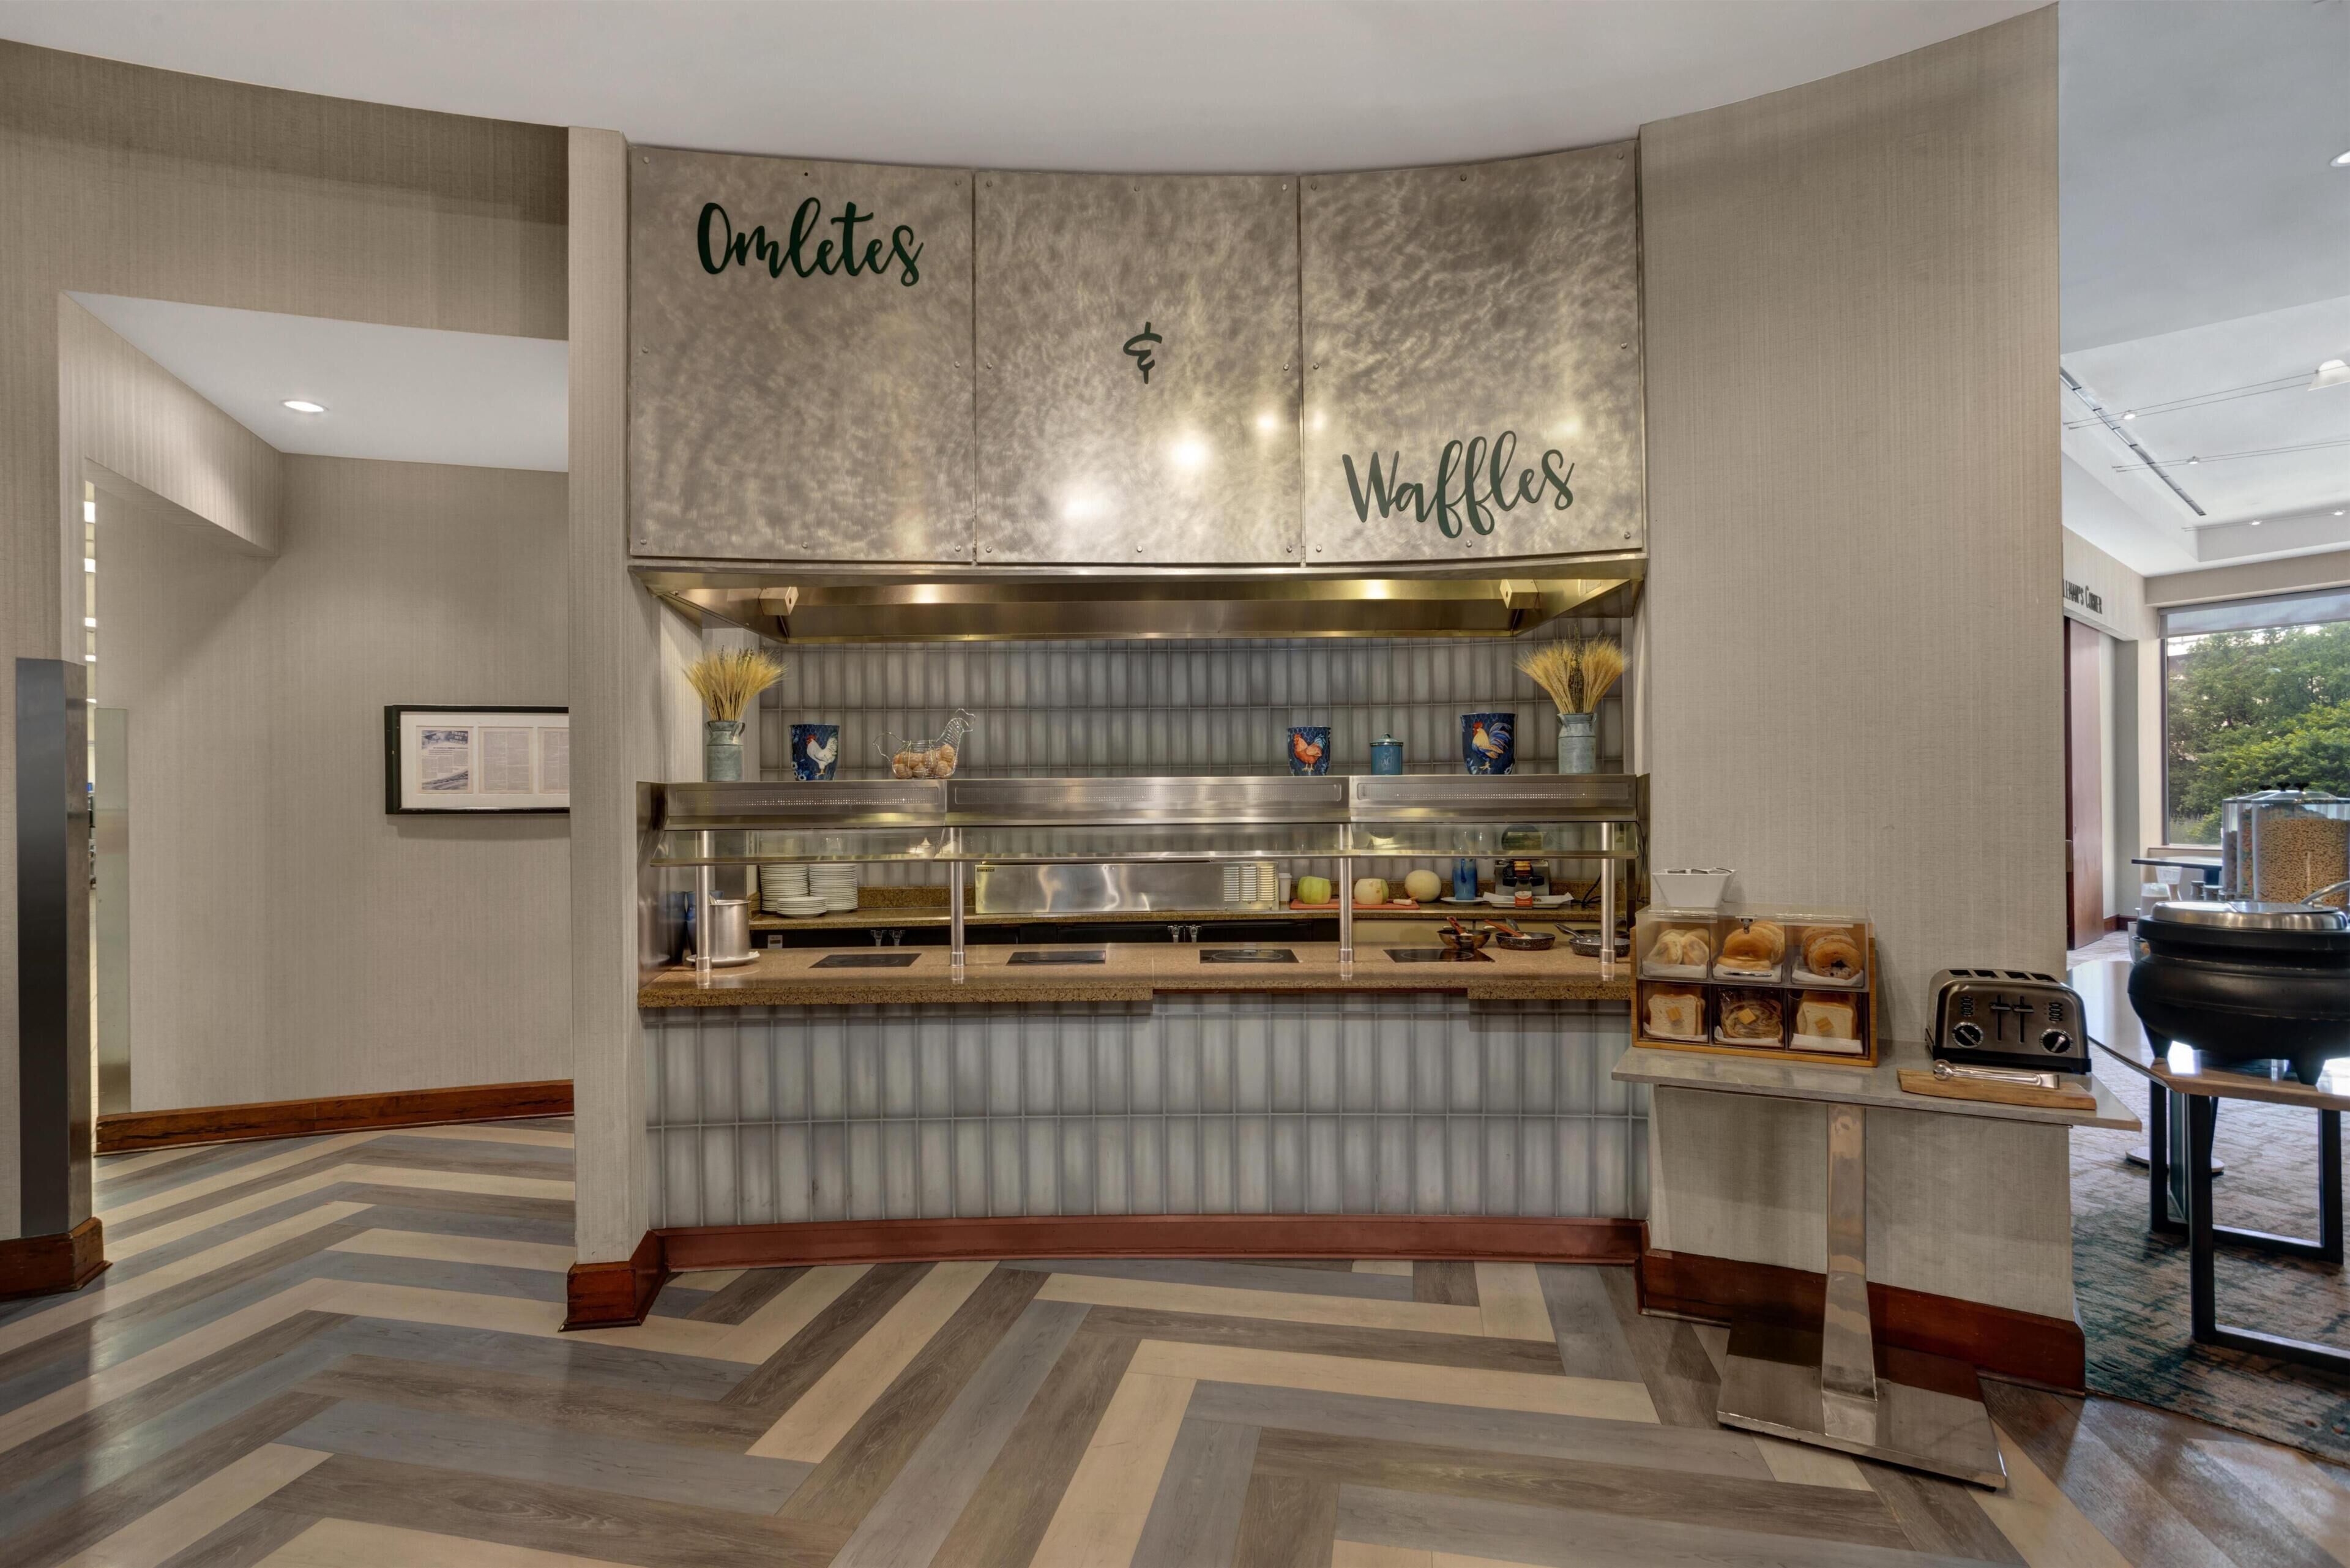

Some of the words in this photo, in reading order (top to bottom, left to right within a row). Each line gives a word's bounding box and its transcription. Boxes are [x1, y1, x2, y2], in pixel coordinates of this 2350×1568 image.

[697, 197, 924, 286] Omletes
[1123, 321, 1162, 384] &
[1342, 431, 1575, 538] Waffles
